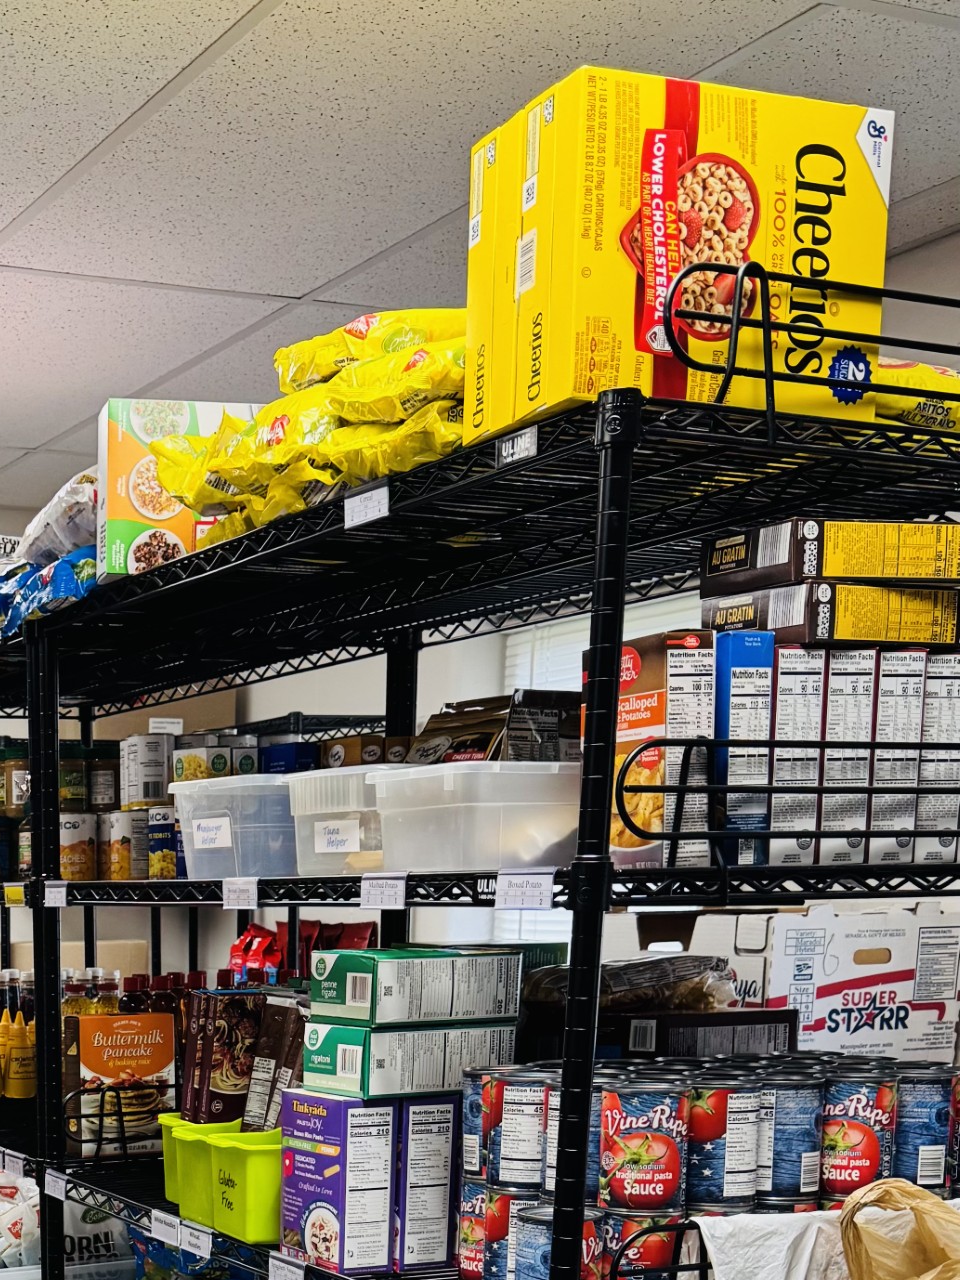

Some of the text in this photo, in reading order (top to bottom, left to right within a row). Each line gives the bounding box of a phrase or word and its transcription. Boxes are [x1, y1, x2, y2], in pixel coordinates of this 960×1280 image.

[587, 75, 596, 88] NET
[598, 94, 607, 102] LB
[586, 90, 596, 122] WT/PESO
[598, 104, 607, 120] 4.35
[598, 121, 607, 130] OZ
[586, 124, 595, 142] NETO
[585, 151, 594, 160] LB
[584, 174, 593, 184] OZ
[642, 171, 651, 183] AS
[641, 185, 651, 204] PART
[642, 206, 652, 217] OF
[665, 201, 678, 235] CAN
[771, 188, 787, 248] 100%
[594, 193, 604, 252] CARTONS/CAJAS
[651, 133, 667, 320] LOWER CHOLESTEROL
[643, 226, 654, 251] HEART
[784, 143, 847, 374] Cheerios
[645, 253, 655, 286] HEALTHY
[646, 288, 655, 306] DIET
[600, 319, 610, 334] 140
[527, 312, 543, 402] Cheerios
[472, 343, 486, 429] Cheerios
[913, 401, 952, 417] ARITOS
[501, 431, 532, 457] ULINE
[712, 545, 746, 567] AU GRATIN
[715, 605, 754, 626] AU GRATIN
[780, 651, 823, 660] Nutrition Facts
[831, 652, 874, 661] Nutrition Facts
[882, 654, 924, 663] Nutrition Facts
[732, 670, 769, 679] Nutrition Facts
[692, 683, 702, 691] 100
[703, 683, 713, 691] 170
[800, 684, 808, 693] 90
[811, 684, 821, 693] 140
[622, 708, 651, 722] Potatoes
[451, 753, 471, 761] CHEESY
[323, 825, 340, 835] Tuna
[326, 837, 349, 848] Helper
[507, 880, 543, 889] Boxed Potato
[795, 930, 816, 938] Variety
[795, 938, 822, 946] Maradol
[795, 945, 816, 953] Hybrid
[321, 981, 338, 990] penne
[794, 986, 809, 994] Size
[321, 988, 337, 998] rigate
[841, 990, 898, 1007] SUPER
[91, 1030, 164, 1047] Buttermilk
[101, 1046, 154, 1061] pancake
[310, 1053, 331, 1063] rigatoni
[114, 1058, 137, 1068] baking
[138, 1058, 152, 1066] mix
[292, 1100, 327, 1117] Tinkyáda
[503, 1106, 544, 1114] Calories 45
[763, 1110, 774, 1118] 45
[847, 1094, 891, 1125] Ripe
[605, 1105, 688, 1138] Vine Ripe
[376, 1128, 390, 1136] 210
[437, 1125, 450, 1133] 210
[294, 1153, 316, 1164] DEDICATED
[623, 1161, 666, 1170] low sodium
[822, 1164, 860, 1180] Sauce
[217, 1167, 238, 1190] Gluten-
[615, 1170, 673, 1181] traditional pasta
[623, 1180, 664, 1195] Sauce
[220, 1191, 235, 1212] Free
[460, 1256, 484, 1272] Sauce
